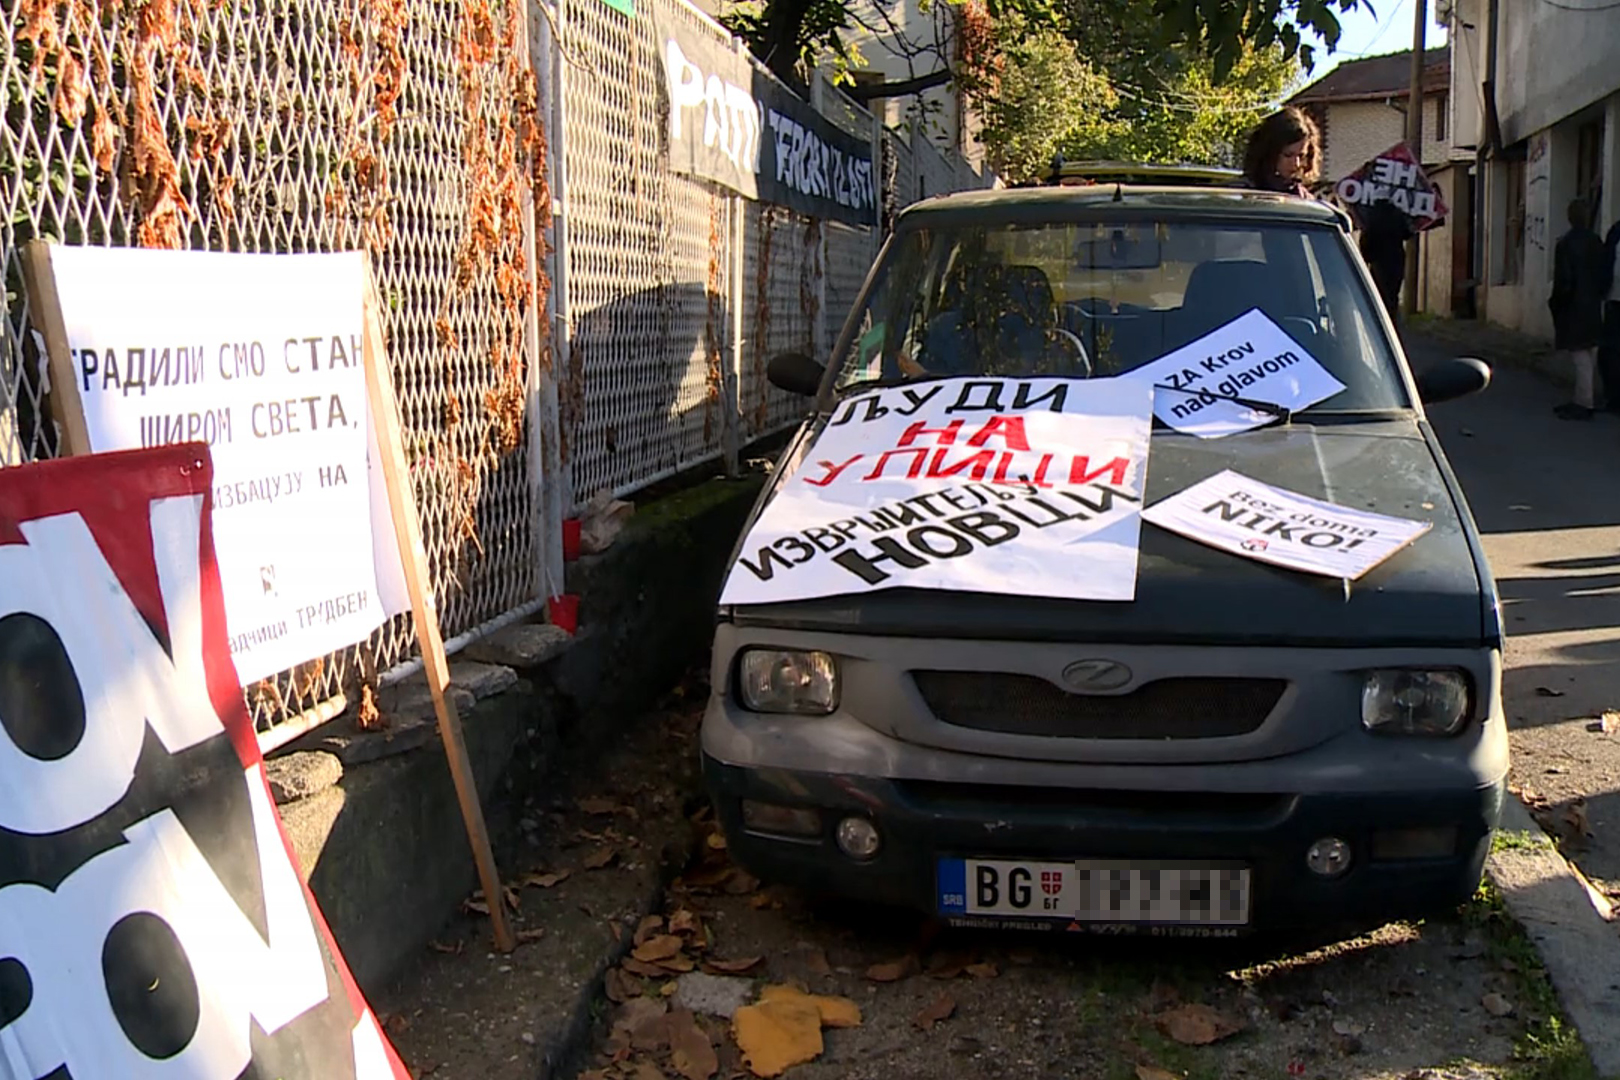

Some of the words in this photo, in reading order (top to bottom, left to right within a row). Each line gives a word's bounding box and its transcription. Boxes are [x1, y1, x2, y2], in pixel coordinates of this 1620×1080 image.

[72, 346, 204, 397] РАДИЛИ
[219, 341, 265, 380] СМО
[1200, 341, 1256, 374] Krov
[830, 381, 1070, 427] ЉУДИ
[1171, 387, 1217, 419] nad
[1218, 349, 1301, 400] glavom
[252, 394, 358, 438] СВЕТА,
[896, 415, 1031, 452] НА
[319, 464, 349, 489] НА
[803, 447, 1131, 488] УЛИЦИ
[831, 483, 1141, 586] НОВЦИ
[1202, 499, 1365, 554] NIKO!
[1228, 491, 1286, 514] Bez
[1290, 513, 1378, 537] doma
[942, 894, 963, 906] SRB
[976, 864, 1032, 909] BG
